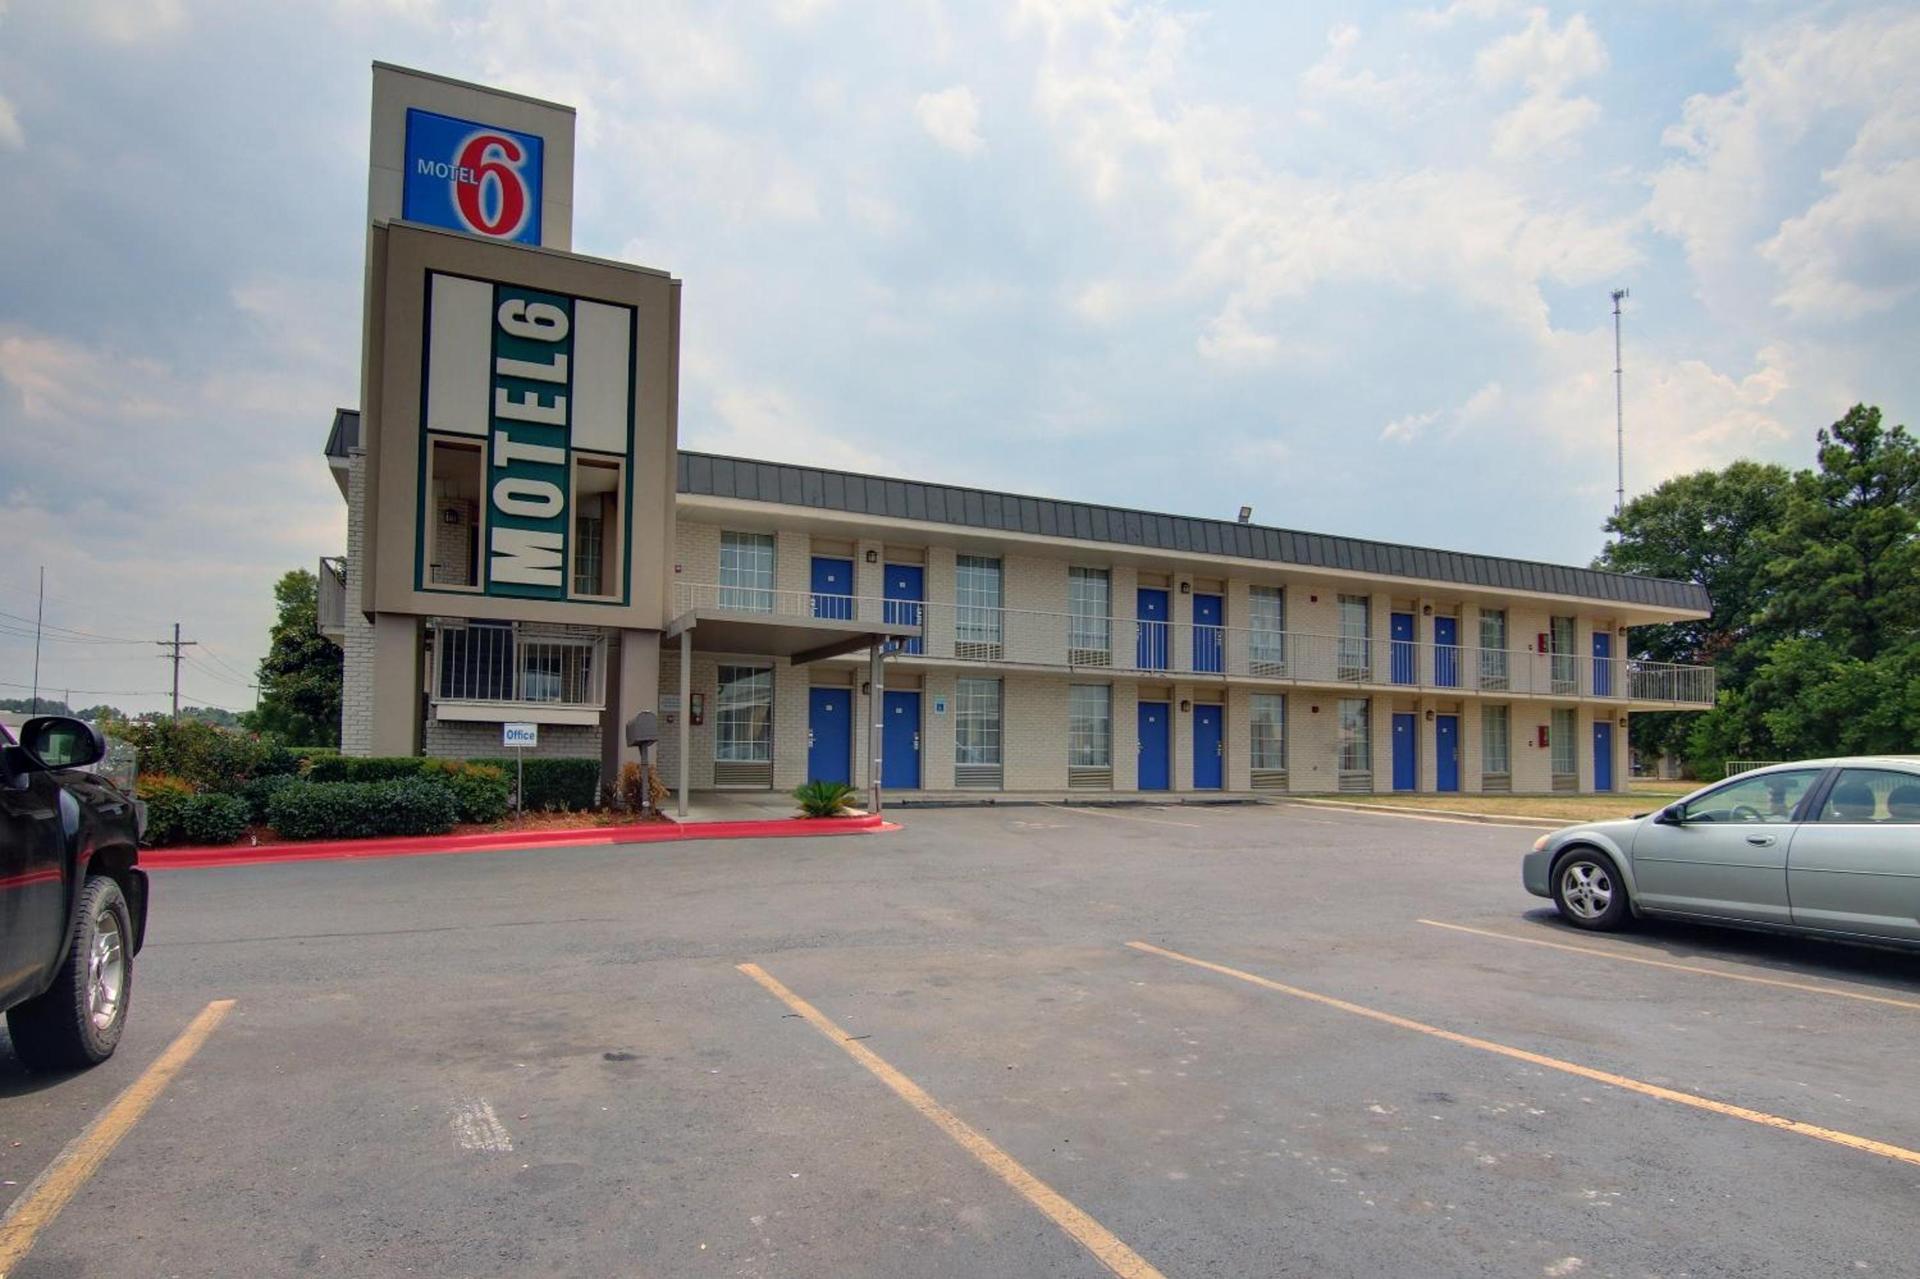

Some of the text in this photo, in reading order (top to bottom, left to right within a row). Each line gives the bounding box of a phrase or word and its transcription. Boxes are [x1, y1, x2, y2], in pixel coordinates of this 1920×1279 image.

[417, 134, 527, 237] MOTEL 6
[506, 729, 535, 740] Office
